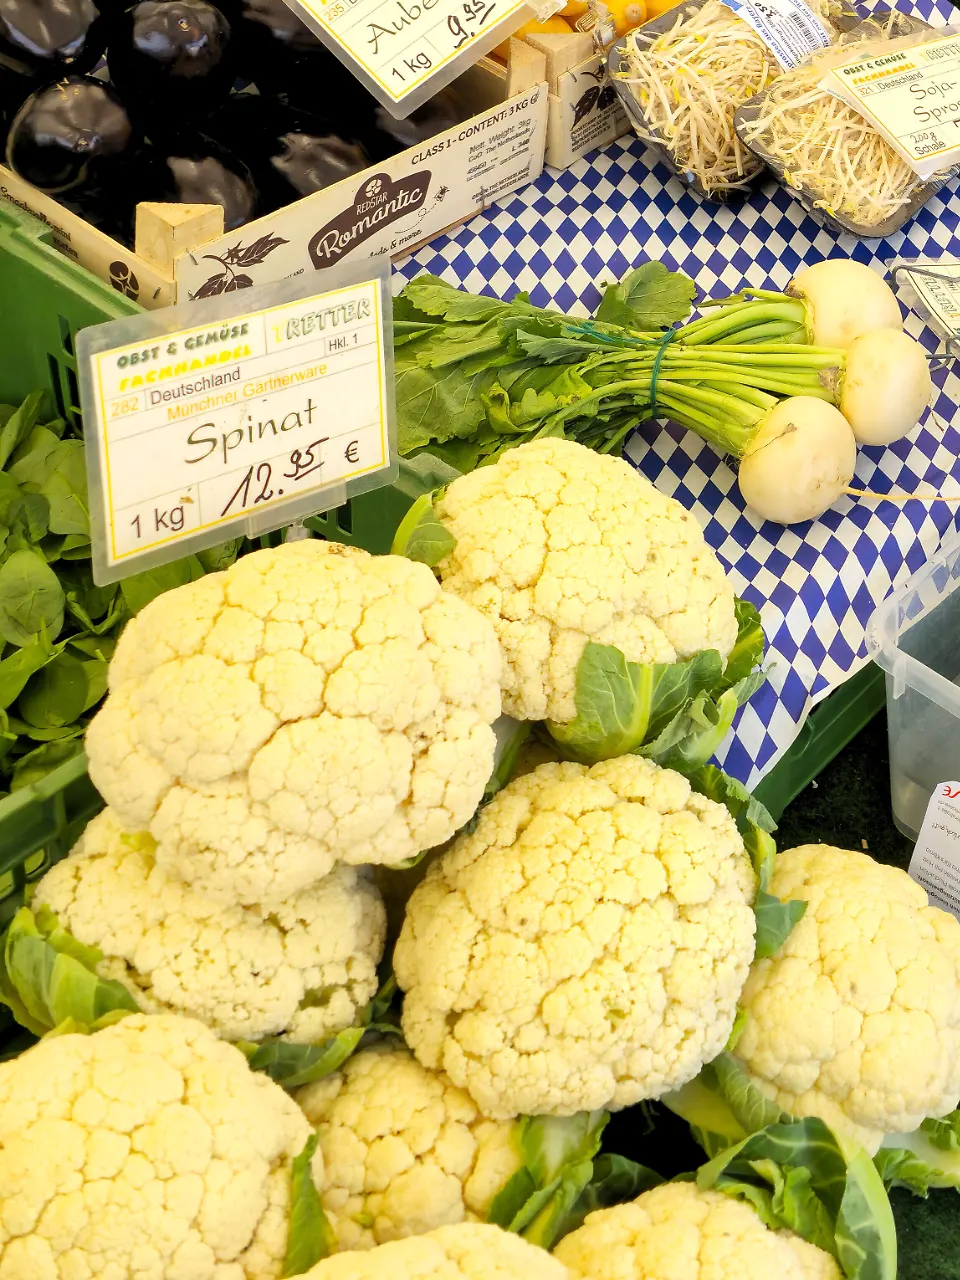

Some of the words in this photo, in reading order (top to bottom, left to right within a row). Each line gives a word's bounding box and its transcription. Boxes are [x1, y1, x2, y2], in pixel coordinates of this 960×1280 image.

[325, 3, 346, 22] 235
[392, 67, 406, 82] 1
[409, 52, 432, 77] kg
[843, 65, 865, 75] OBST
[874, 52, 907, 67] GEMÜSE
[879, 71, 924, 90] Deutschland
[909, 80, 958, 100] Soja-
[411, 144, 444, 166] CLASS
[446, 139, 452, 149] 1
[458, 111, 508, 142] CONTENT:
[509, 106, 515, 116] 3
[515, 99, 529, 112] KG
[914, 140, 946, 155] Schale
[356, 191, 388, 215] REDSTAR
[316, 186, 423, 259] Romantic
[116, 350, 160, 369] OBST
[166, 342, 178, 355] &
[184, 322, 249, 350] GEMÜSE
[328, 336, 349, 351] Hkl.
[353, 334, 358, 344] 1
[119, 346, 252, 392] FACHHANDEL
[110, 396, 139, 418] 282
[151, 367, 241, 406] Deutschland
[166, 391, 238, 421] Münchner
[242, 364, 328, 398] Gärtnerware
[184, 398, 318, 465] Spinat
[131, 514, 142, 538] 1
[154, 504, 185, 532] kg
[221, 437, 330, 517] 12.95
[344, 440, 360, 464] €
